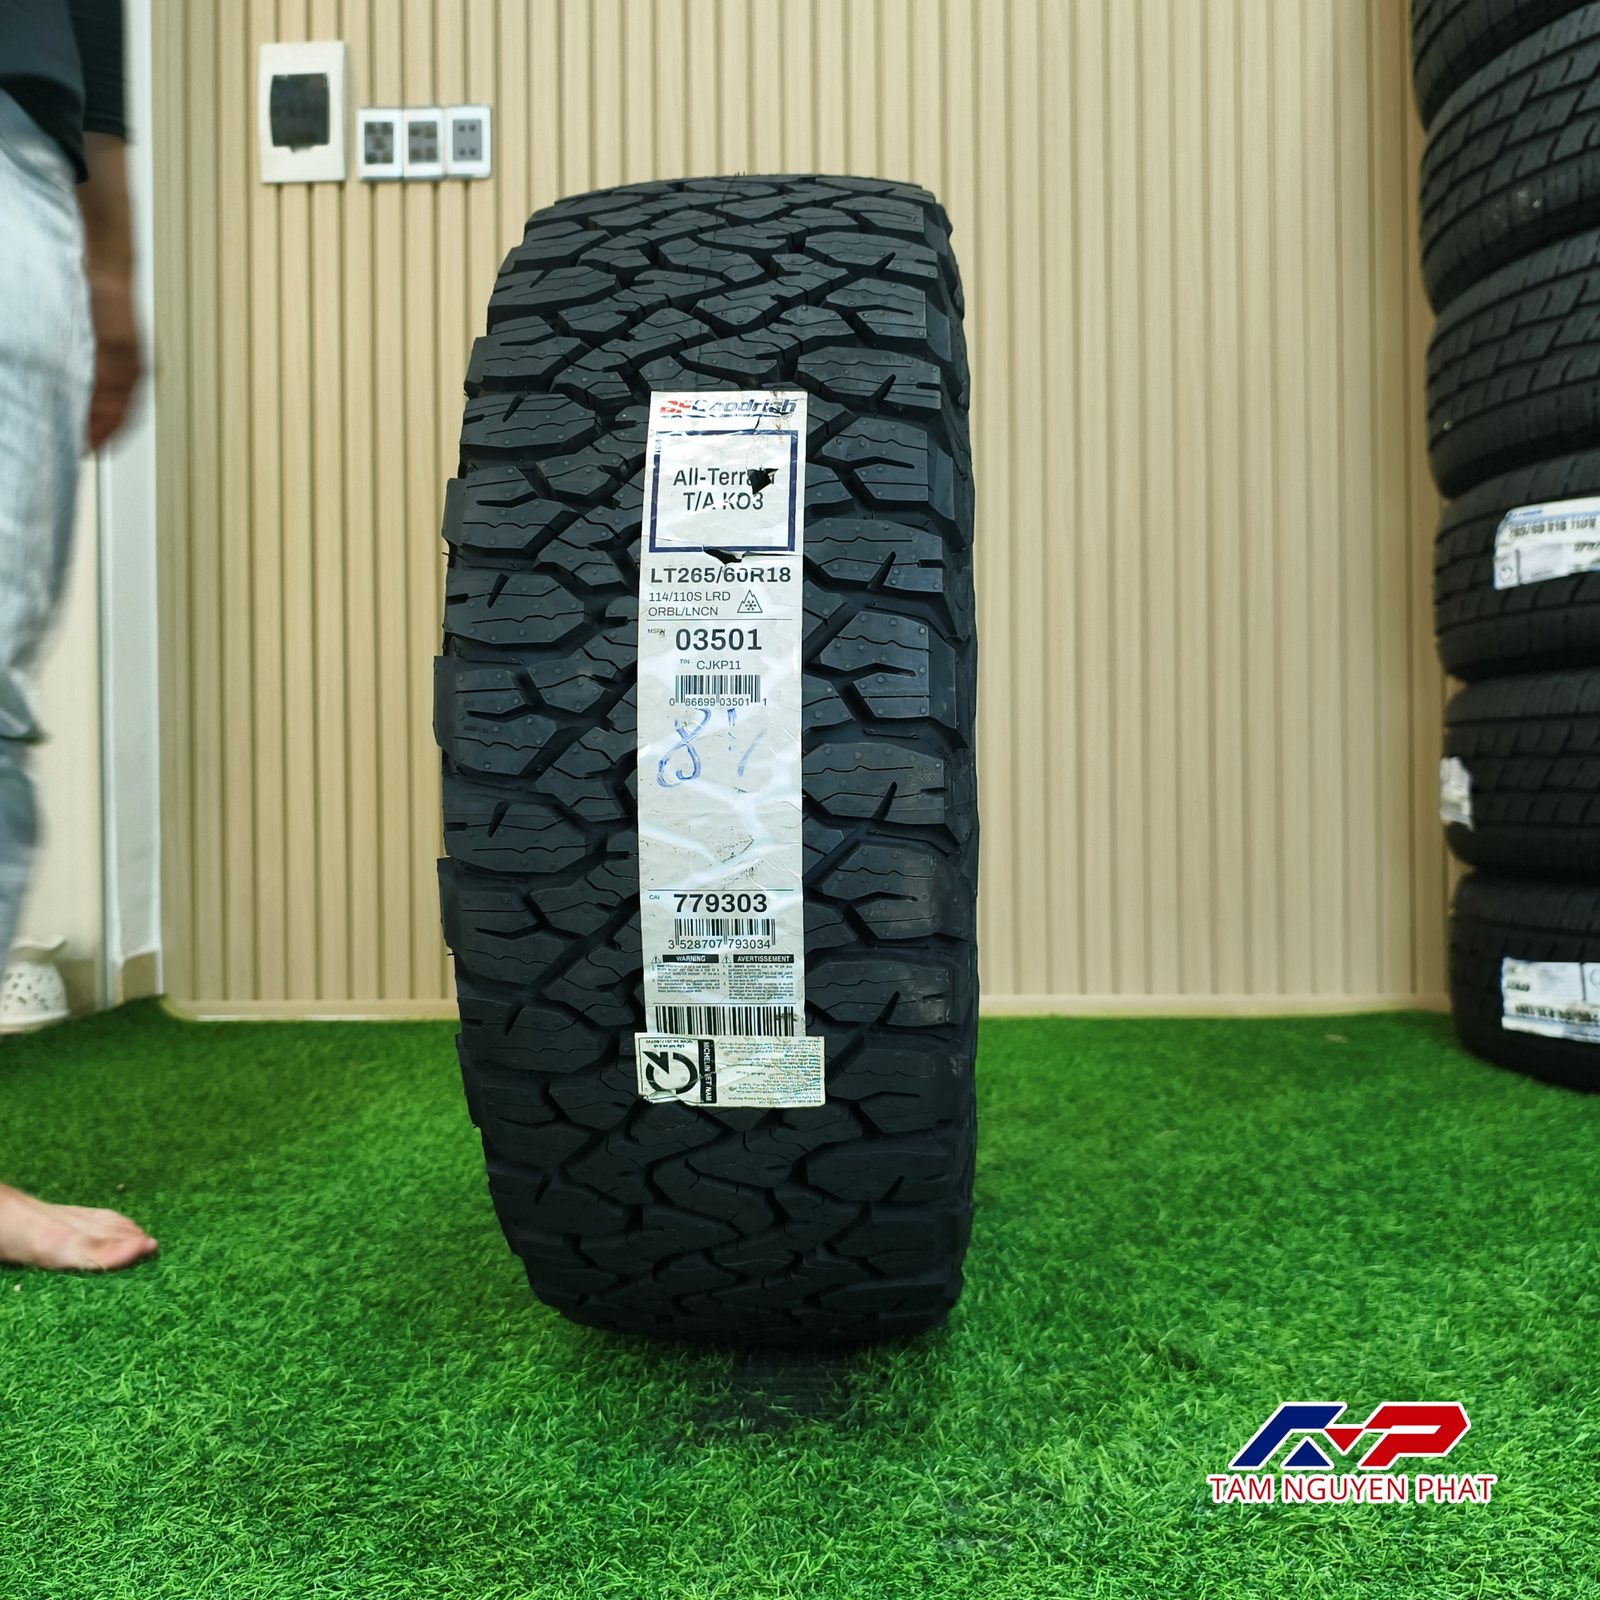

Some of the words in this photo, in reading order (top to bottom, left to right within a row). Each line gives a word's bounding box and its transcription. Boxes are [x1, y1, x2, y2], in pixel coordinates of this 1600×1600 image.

[723, 491, 764, 511] KO3
[650, 566, 792, 584] LT265/60R18
[648, 592, 702, 602] 114/110S
[706, 591, 731, 601] LRD
[648, 606, 719, 616] ORBL/LNCN
[675, 628, 762, 651] 03501
[696, 660, 742, 670] CJKP11
[668, 697, 676, 707] 0
[685, 697, 716, 707] 86699
[719, 697, 750, 707] 03501
[762, 697, 767, 707] 1
[673, 893, 768, 913] 779303
[668, 939, 675, 950] 3
[679, 938, 723, 949] 528707
[728, 938, 771, 949] 793034
[737, 955, 791, 963] AVERTISSEMENT
[705, 1086, 713, 1101] NAM
